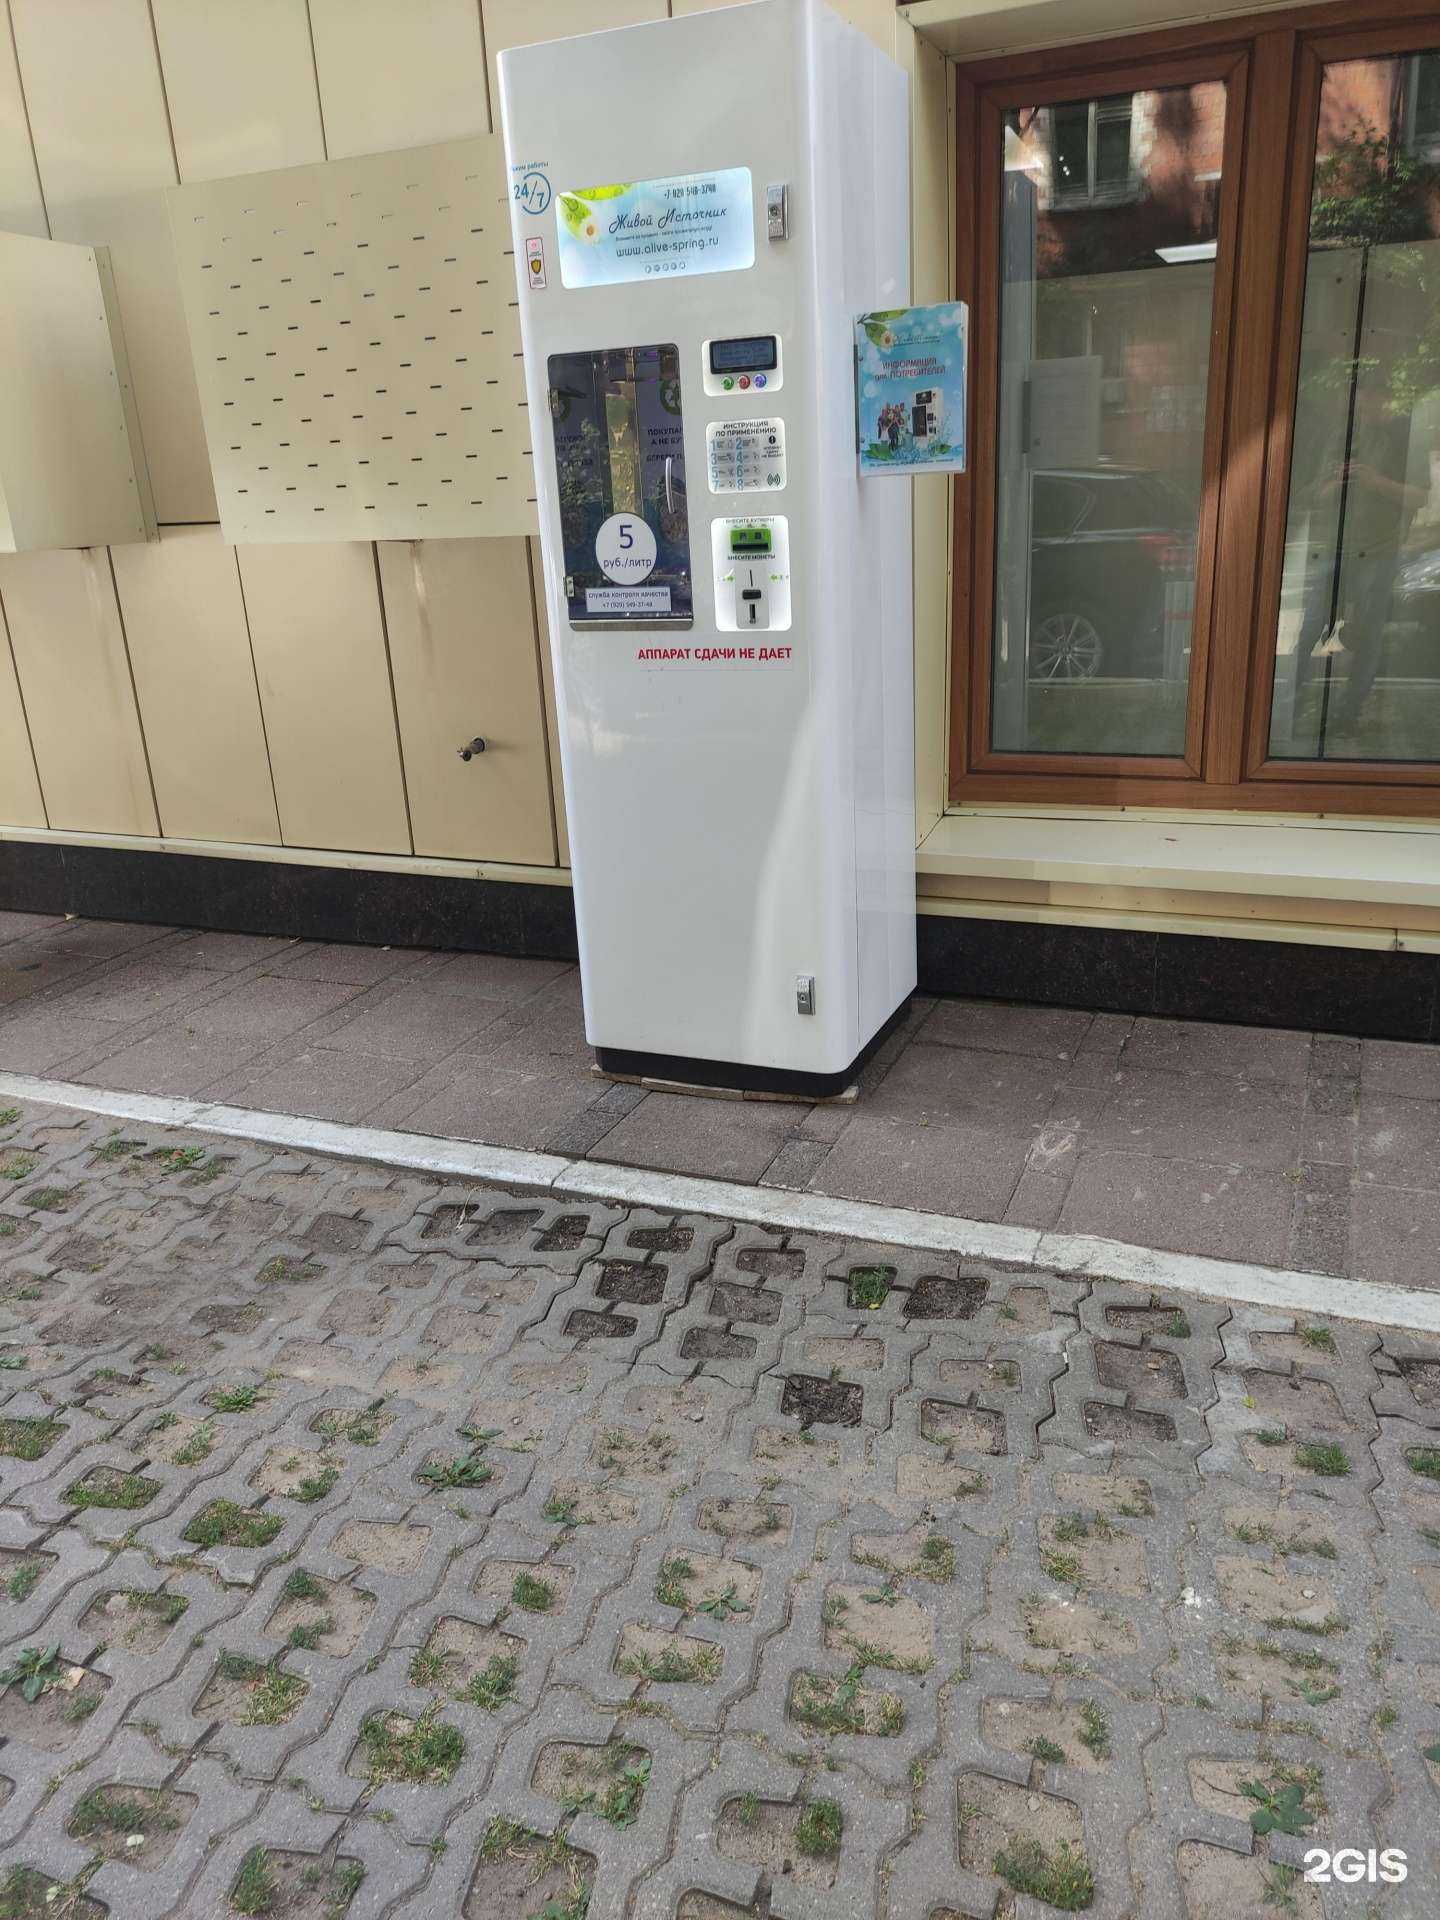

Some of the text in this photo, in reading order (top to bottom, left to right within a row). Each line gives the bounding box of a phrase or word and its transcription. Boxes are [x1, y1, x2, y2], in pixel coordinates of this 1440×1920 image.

[514, 180, 545, 208] 24/7
[608, 213, 653, 234] Живой
[657, 207, 728, 229] Источник
[616, 237, 719, 257] www.alive-spring.ru
[723, 420, 769, 430] ИНСТРУКЦИЯ
[727, 426, 777, 437] ПРИМЕНЕНИЮ
[619, 525, 633, 549] 5
[603, 557, 652, 569] руб./литр
[611, 591, 639, 599] контроля
[638, 647, 792, 661] АППАРАТ СДАЧИ НЕ ДАЕТ
